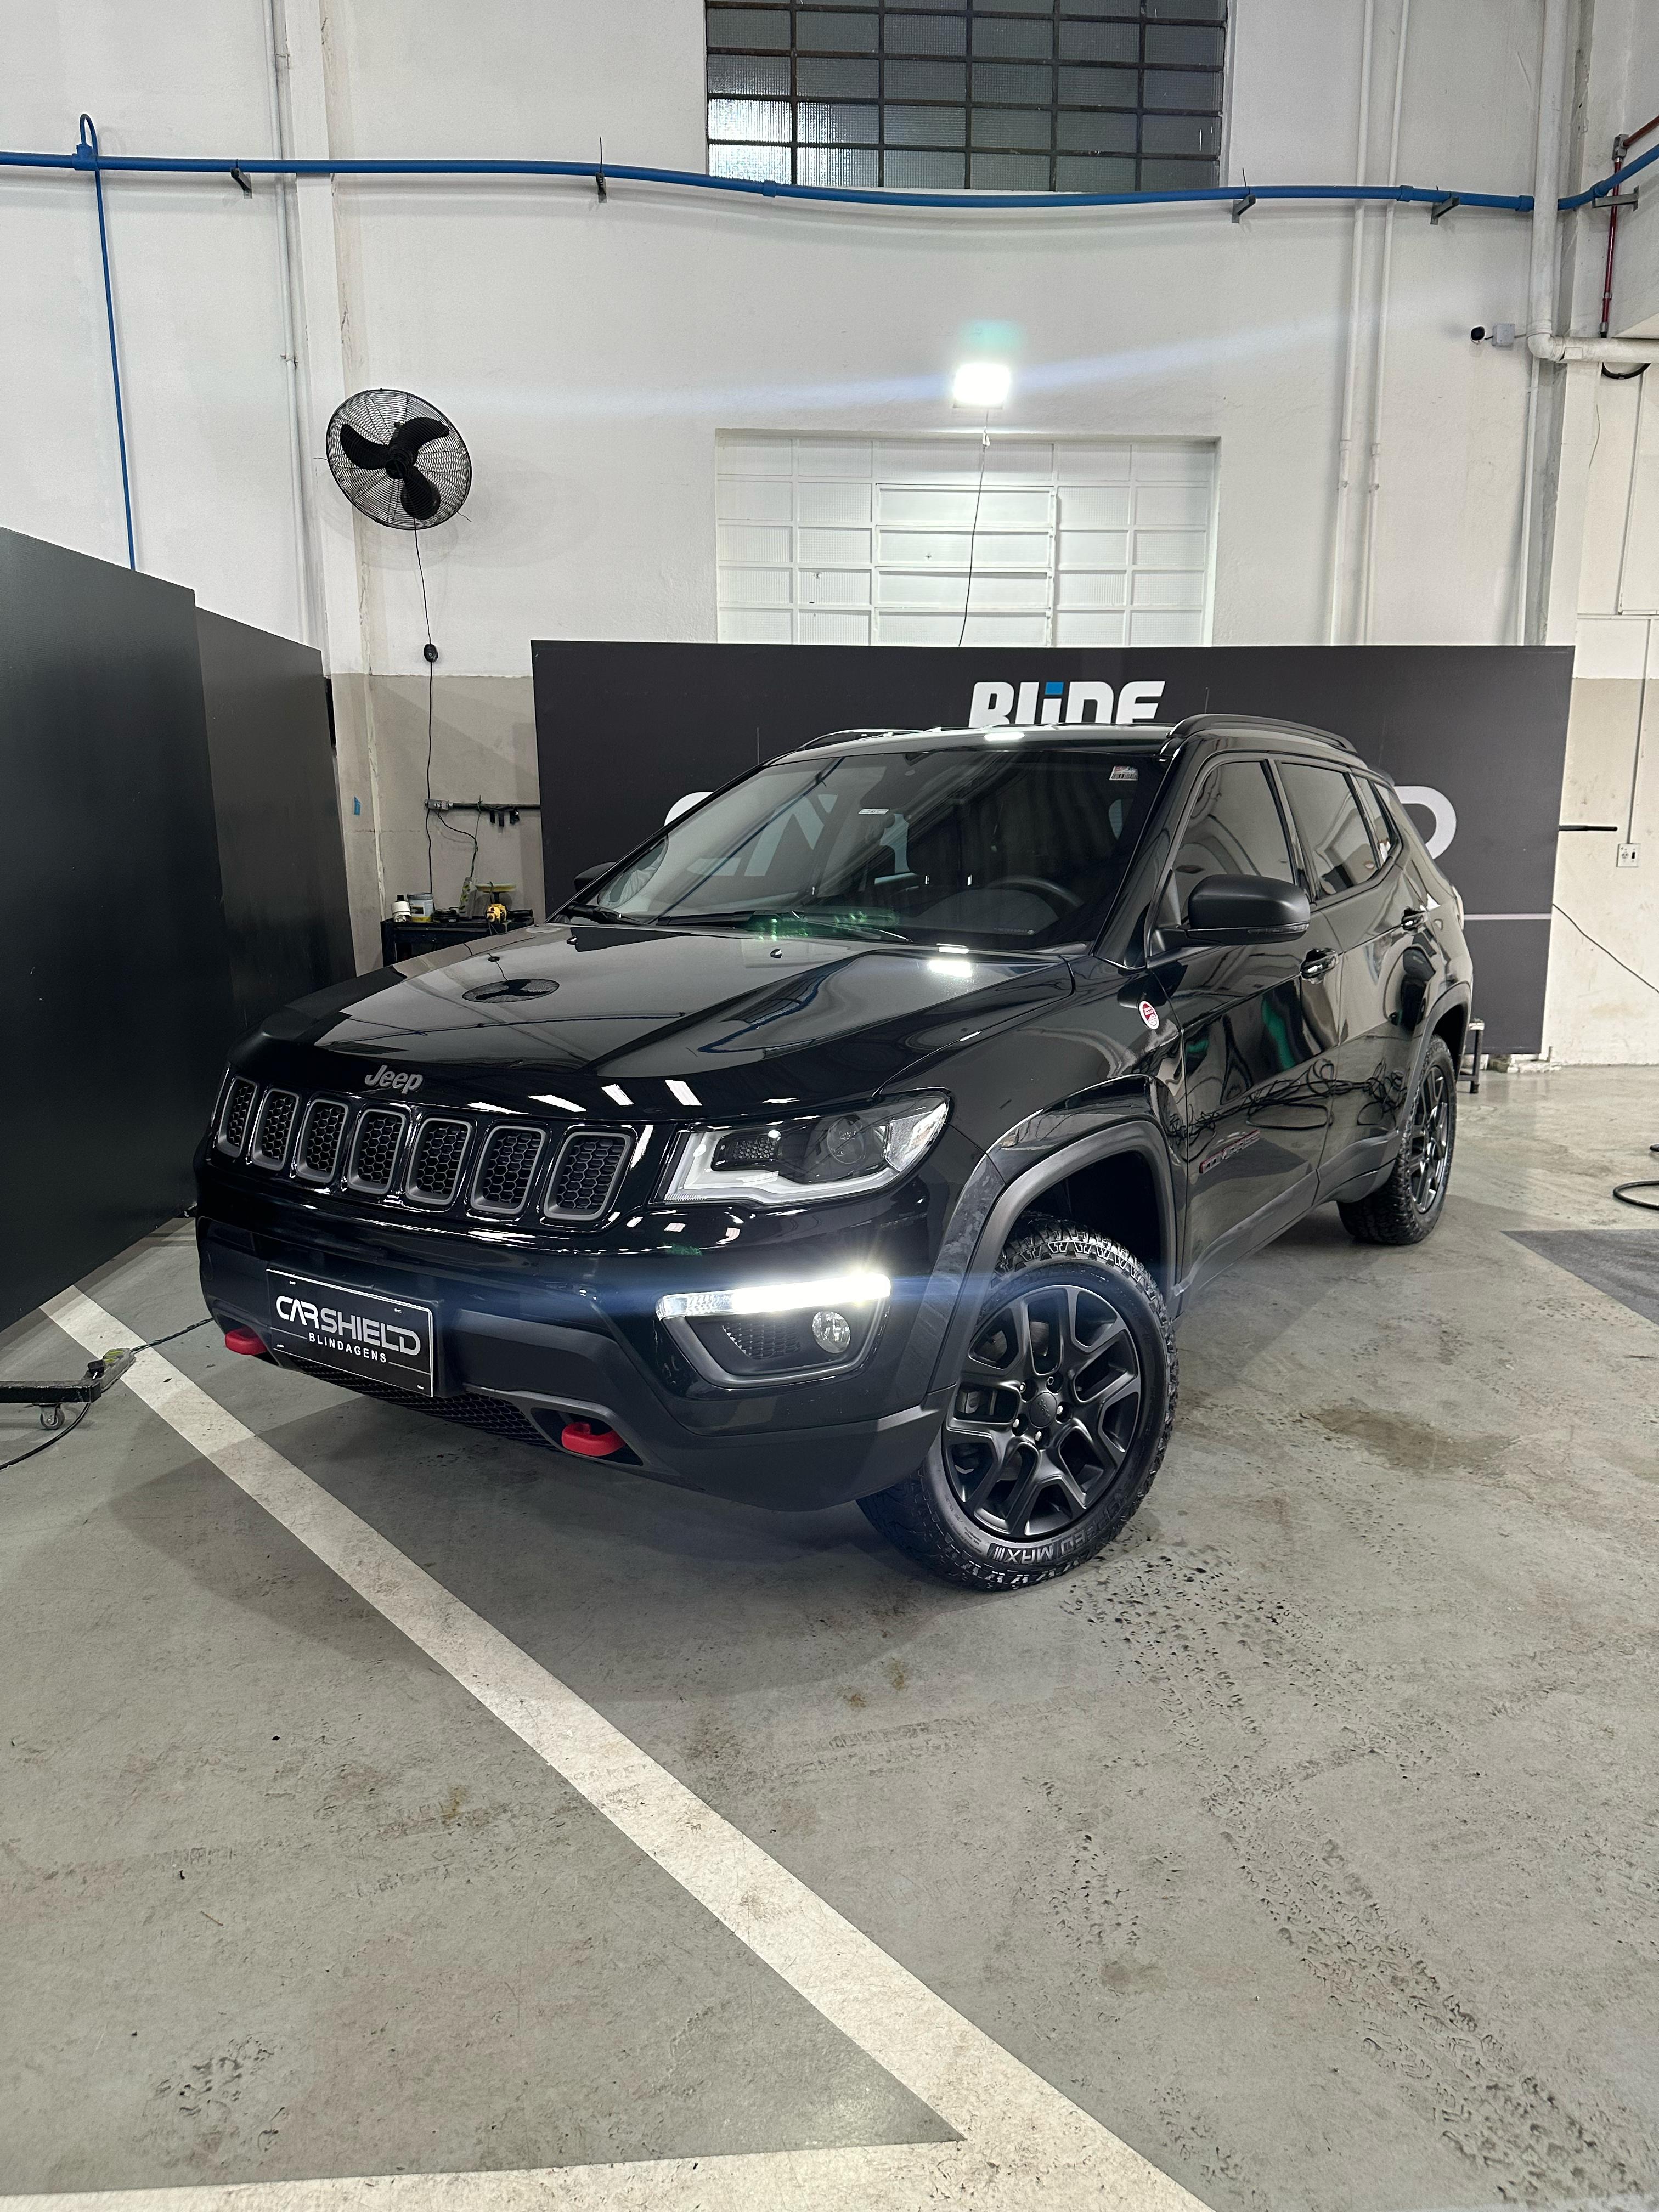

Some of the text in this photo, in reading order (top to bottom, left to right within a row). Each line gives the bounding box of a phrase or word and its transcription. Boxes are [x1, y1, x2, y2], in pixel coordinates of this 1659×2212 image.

[364, 1065, 424, 1095] Jeep
[276, 1295, 421, 1356] CARSHIELD
[309, 1332, 386, 1363] BLINDAGENS
